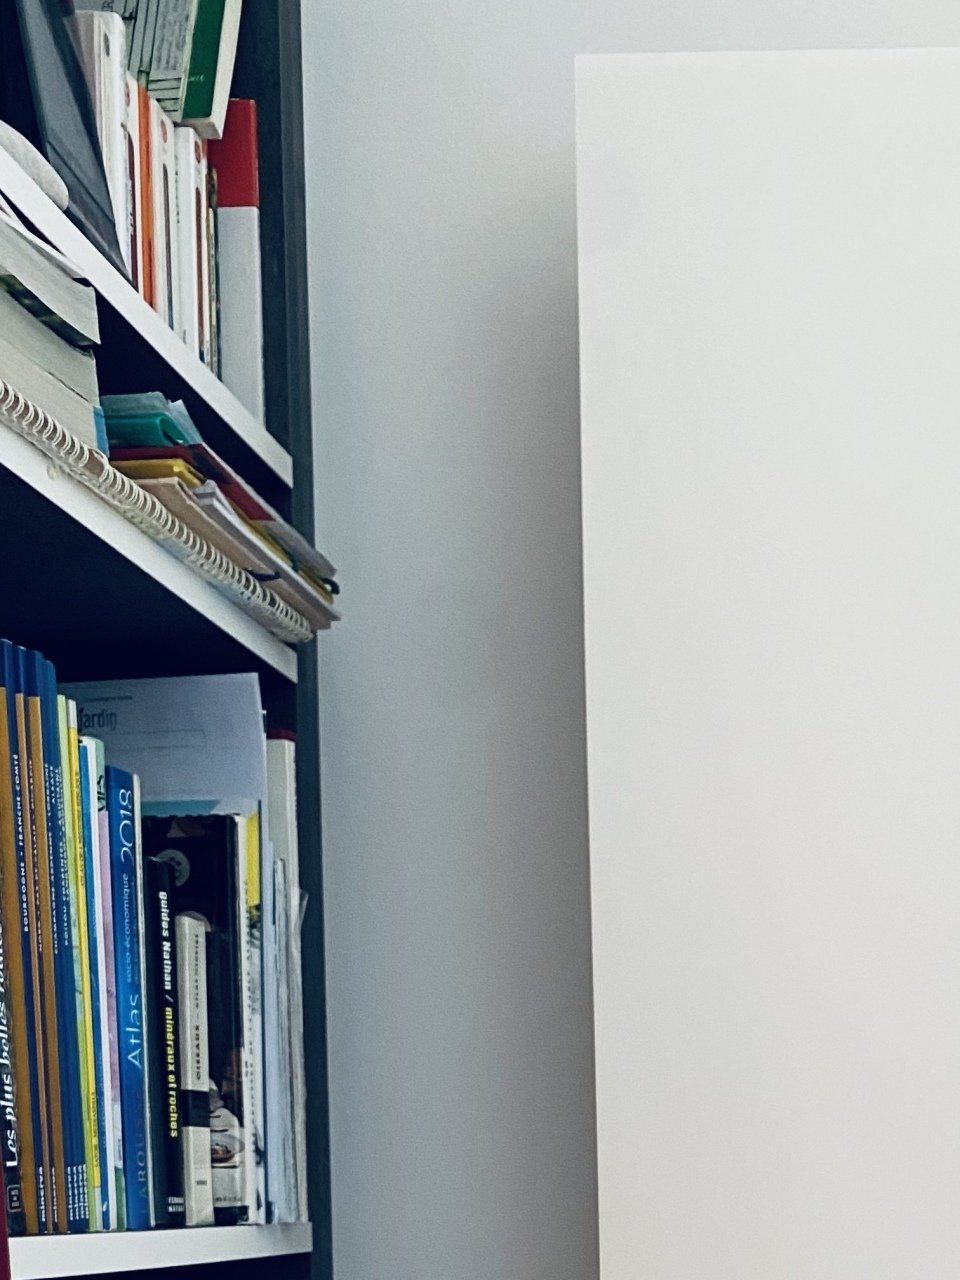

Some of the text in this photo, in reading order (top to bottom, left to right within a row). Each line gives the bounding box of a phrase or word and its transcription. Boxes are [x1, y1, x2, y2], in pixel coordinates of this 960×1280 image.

[13, 754, 29, 932] BOURGOGNE FRANCHE-COMTÉ
[119, 789, 134, 864] 2018
[122, 873, 143, 1069] Atlas socio-économique
[158, 891, 180, 1138] guides Nathan minéraux et roches
[0, 1074, 15, 1120] plus
[5, 1130, 18, 1167] Les
